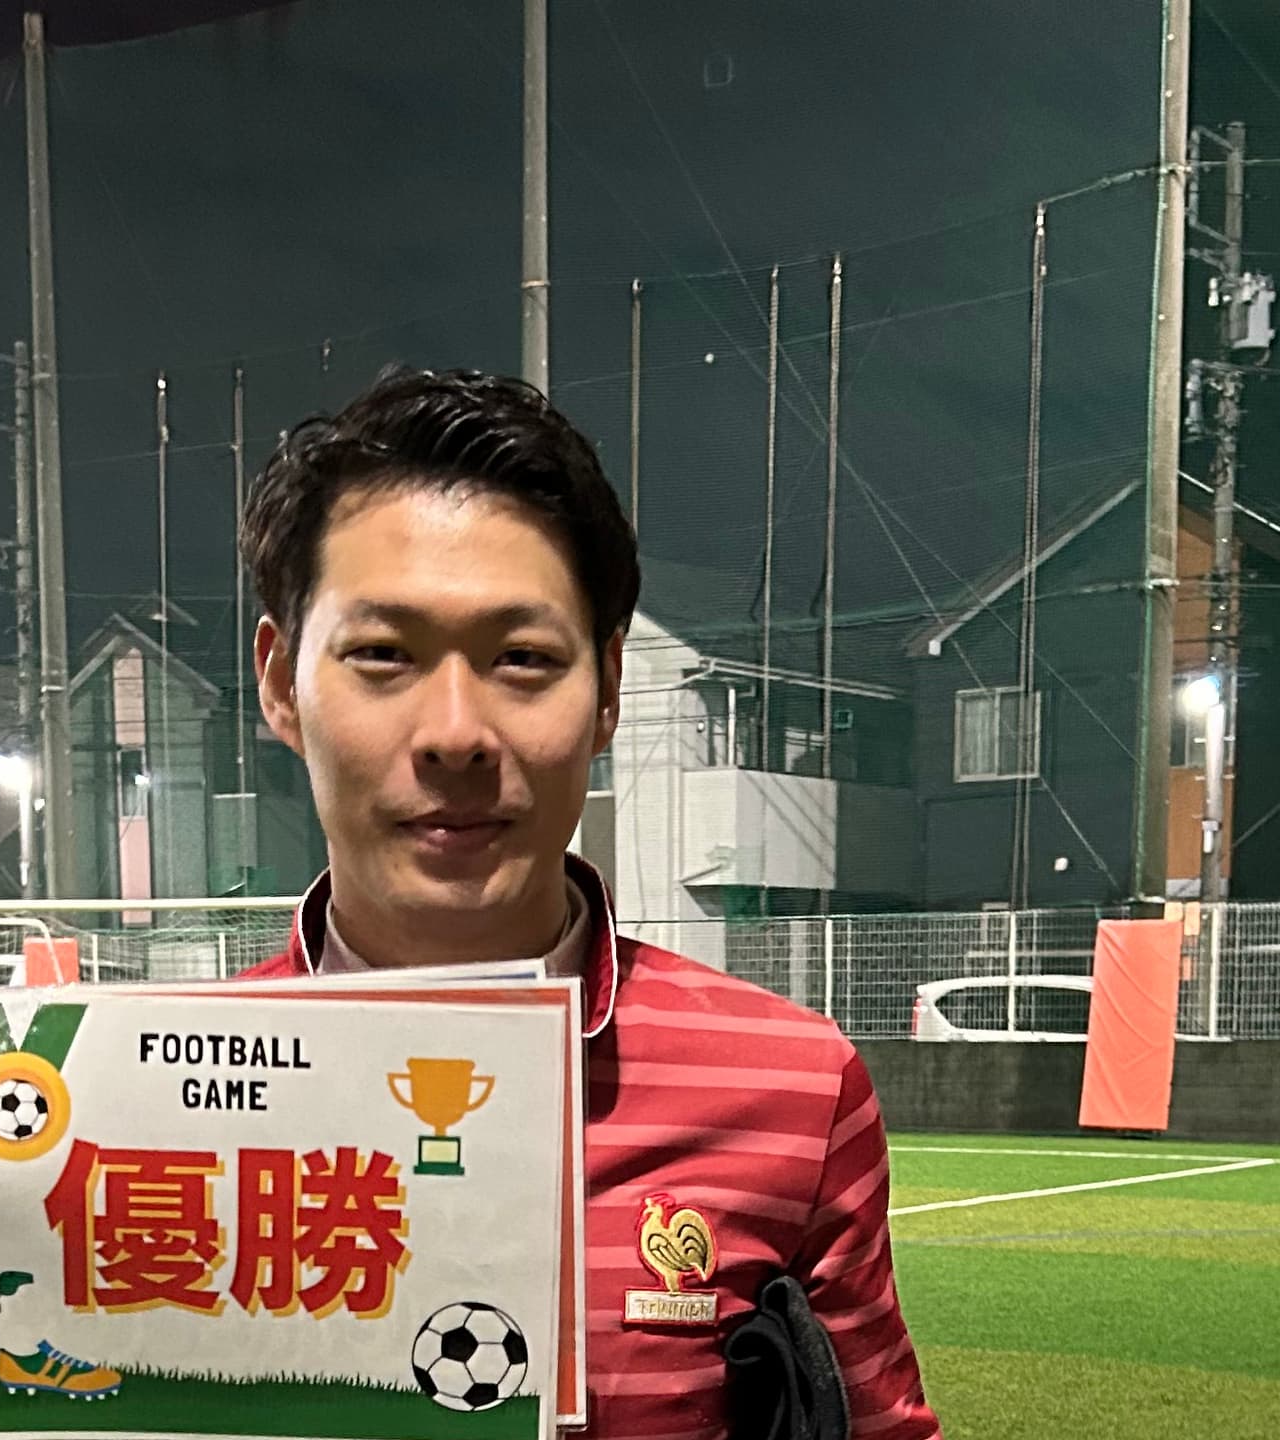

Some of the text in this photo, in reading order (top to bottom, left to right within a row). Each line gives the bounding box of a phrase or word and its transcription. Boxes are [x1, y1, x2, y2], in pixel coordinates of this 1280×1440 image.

[139, 1032, 312, 1070] FOOTBALL
[181, 1078, 269, 1111] GAME
[44, 1139, 410, 1318] 優勝
